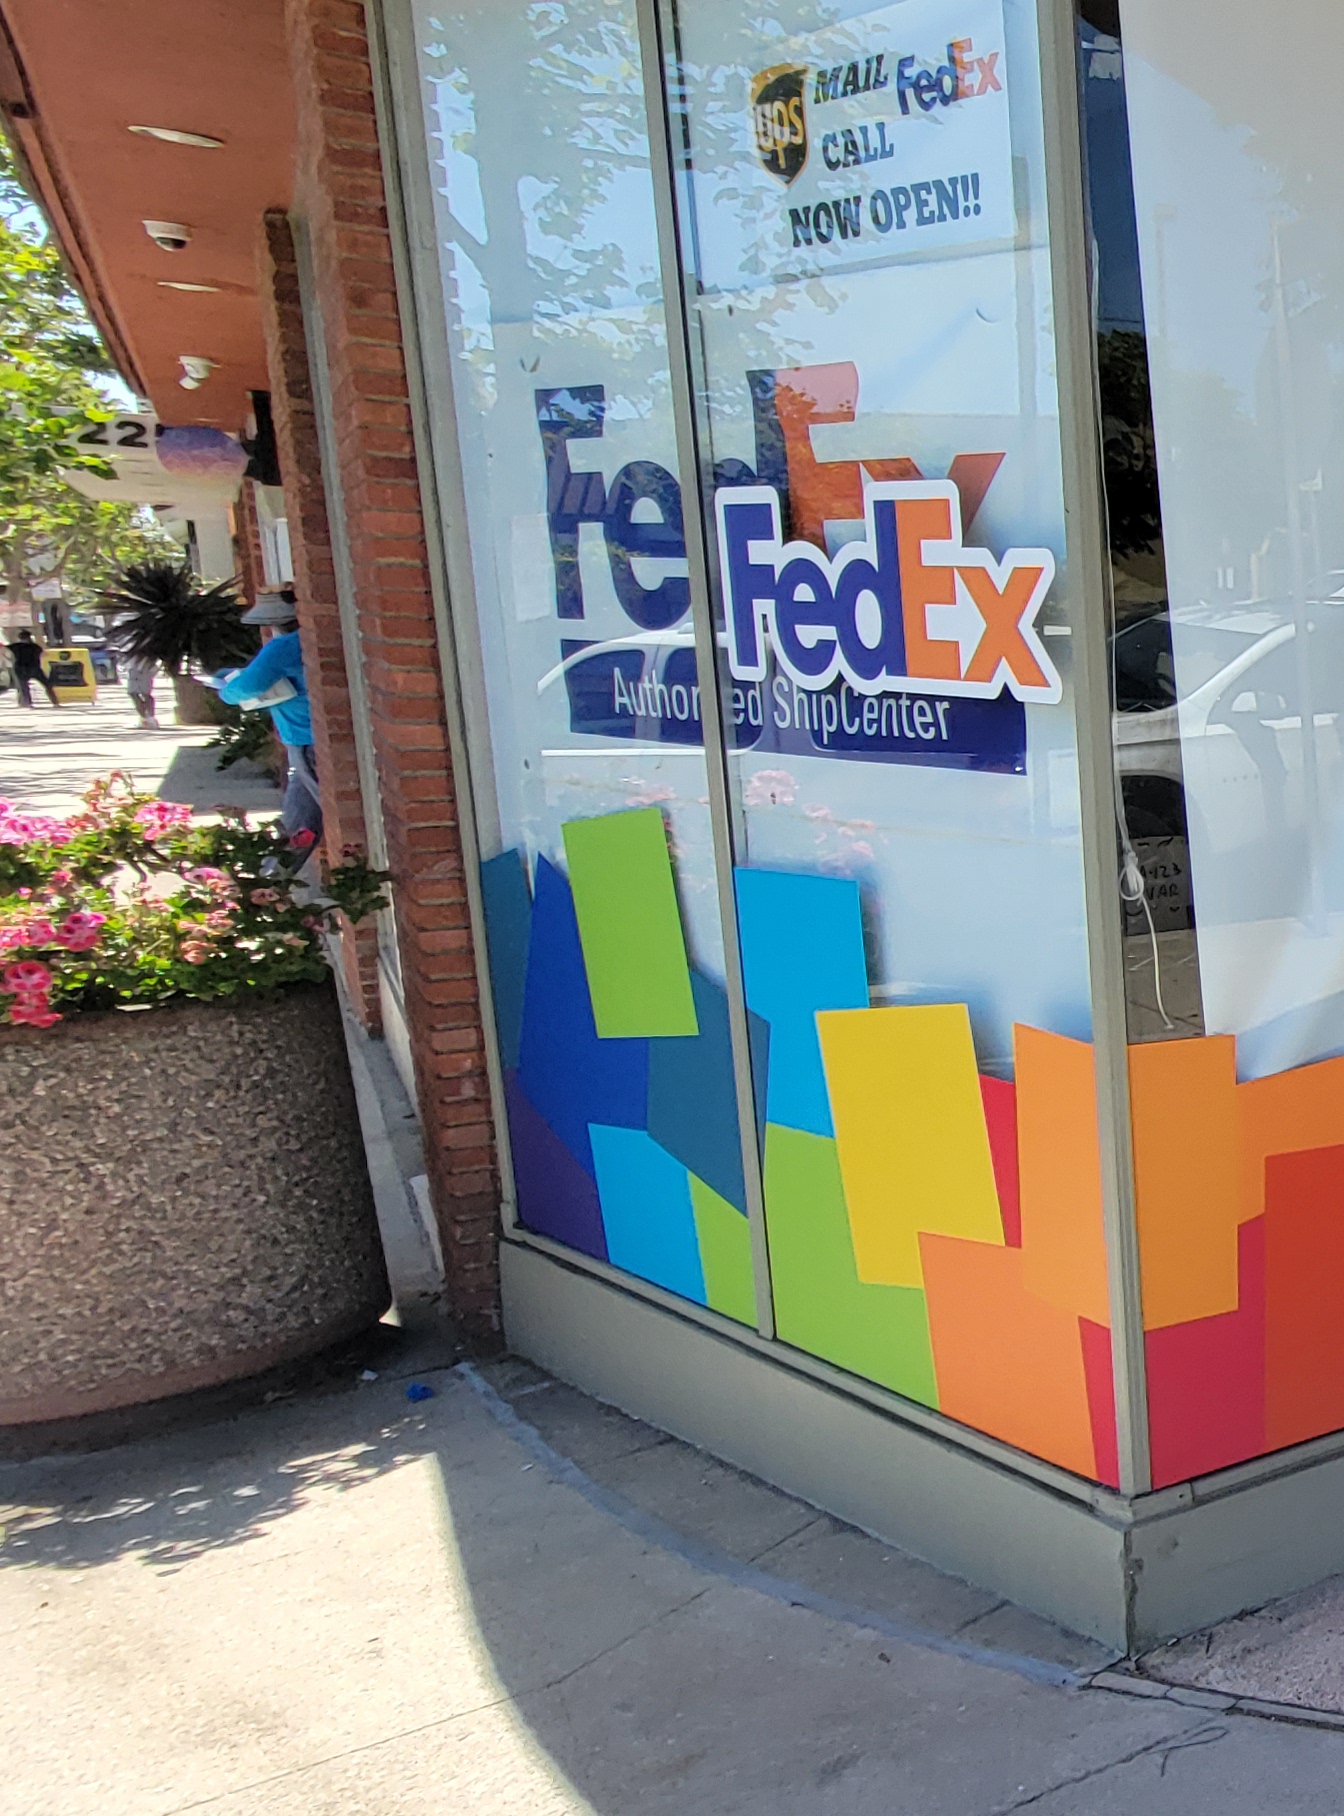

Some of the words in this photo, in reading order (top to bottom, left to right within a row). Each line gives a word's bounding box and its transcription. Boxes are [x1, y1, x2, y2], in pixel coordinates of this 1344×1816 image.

[813, 54, 889, 104] MAIL
[896, 37, 1002, 115] FedEx
[822, 122, 894, 171] CALL
[788, 195, 861, 248] NOW
[870, 172, 981, 234] OPEN!!
[723, 498, 1051, 687] FedEx
[613, 667, 763, 726] Authored
[772, 676, 950, 744] ShipCenter
